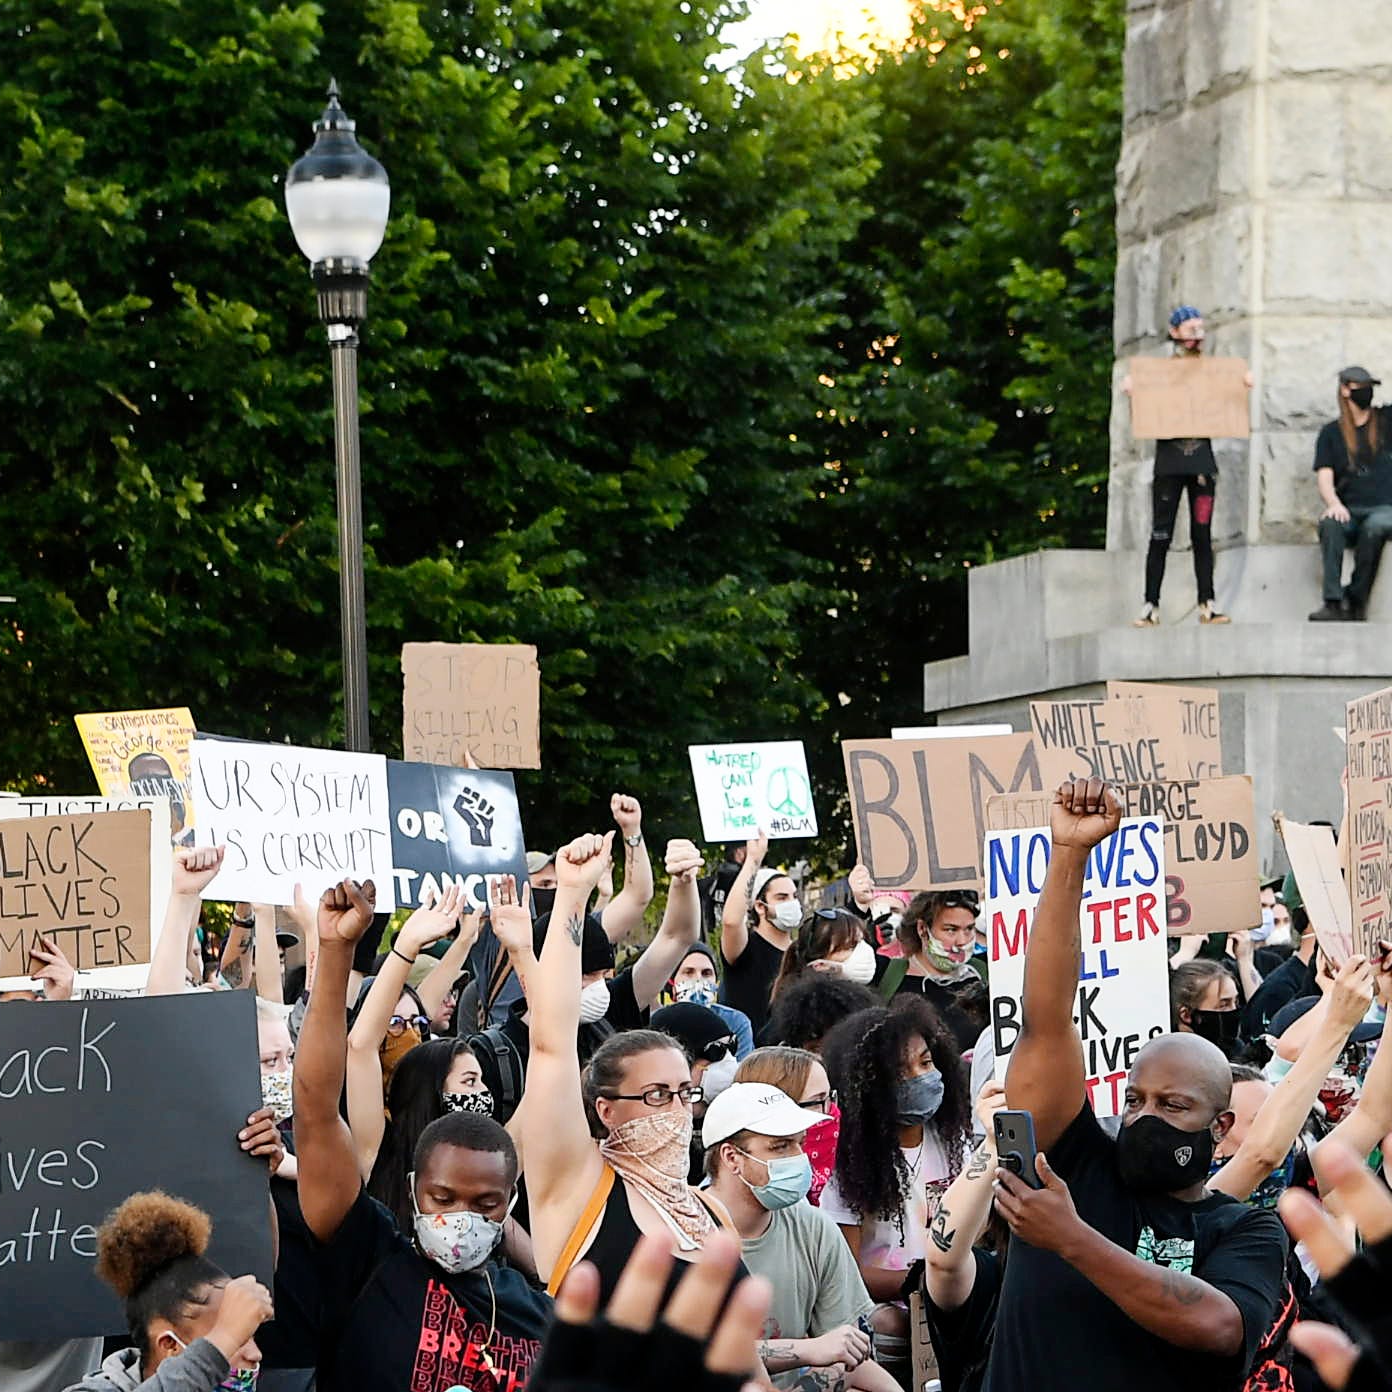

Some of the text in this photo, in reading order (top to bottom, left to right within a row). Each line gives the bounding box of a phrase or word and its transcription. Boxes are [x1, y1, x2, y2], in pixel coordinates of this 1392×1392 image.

[417, 655, 525, 697] STOP
[413, 705, 520, 739] KILLING
[1031, 703, 1109, 748] WHITE
[706, 749, 761, 770] HATRED
[1069, 739, 1167, 783] SILENCE
[199, 758, 263, 812] UR
[271, 761, 372, 819] SYSTEM
[723, 811, 757, 828] HERE
[771, 817, 817, 834] #BLM
[849, 739, 1043, 888] BLM
[263, 828, 387, 876] CORRUPT
[0, 877, 121, 920] LIVES
[992, 893, 1159, 961] MTER
